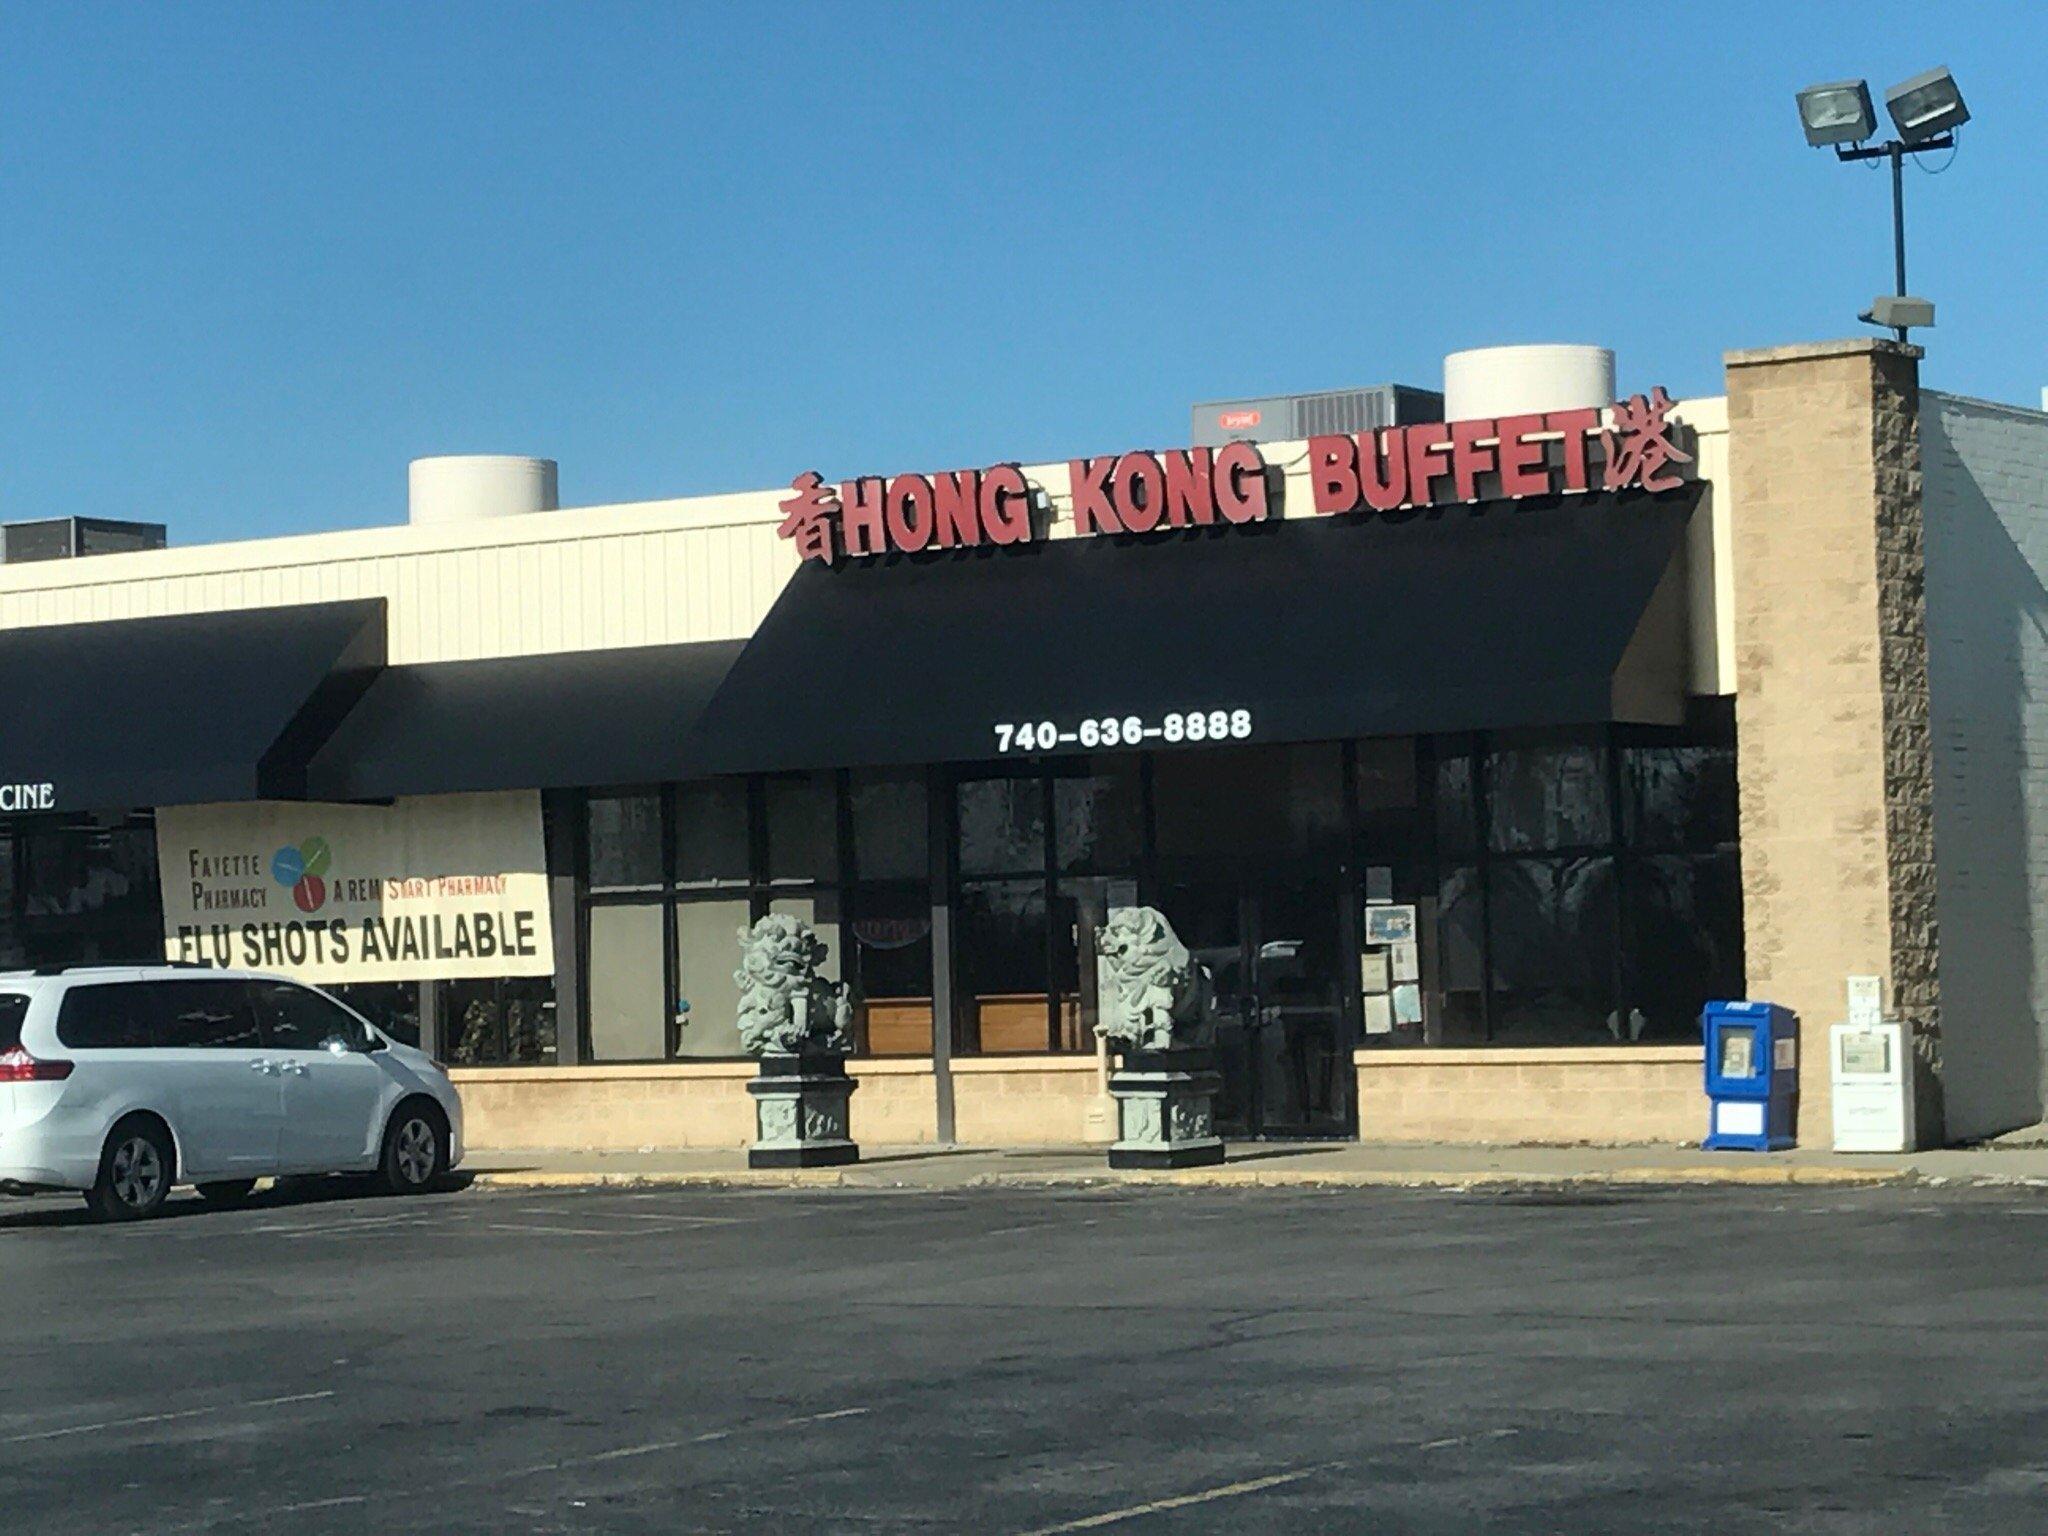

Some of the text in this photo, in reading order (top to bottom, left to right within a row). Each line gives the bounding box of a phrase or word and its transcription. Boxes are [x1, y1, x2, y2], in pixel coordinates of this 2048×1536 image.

[1601, 385, 1693, 493] 港
[777, 471, 841, 567] 香
[841, 407, 1600, 556] HONG KONG BUFFET
[994, 709, 1252, 753] 740-636-8888
[192, 881, 268, 911] PHARMACY
[178, 911, 536, 968] FLU SHOTS AVAILABLE
